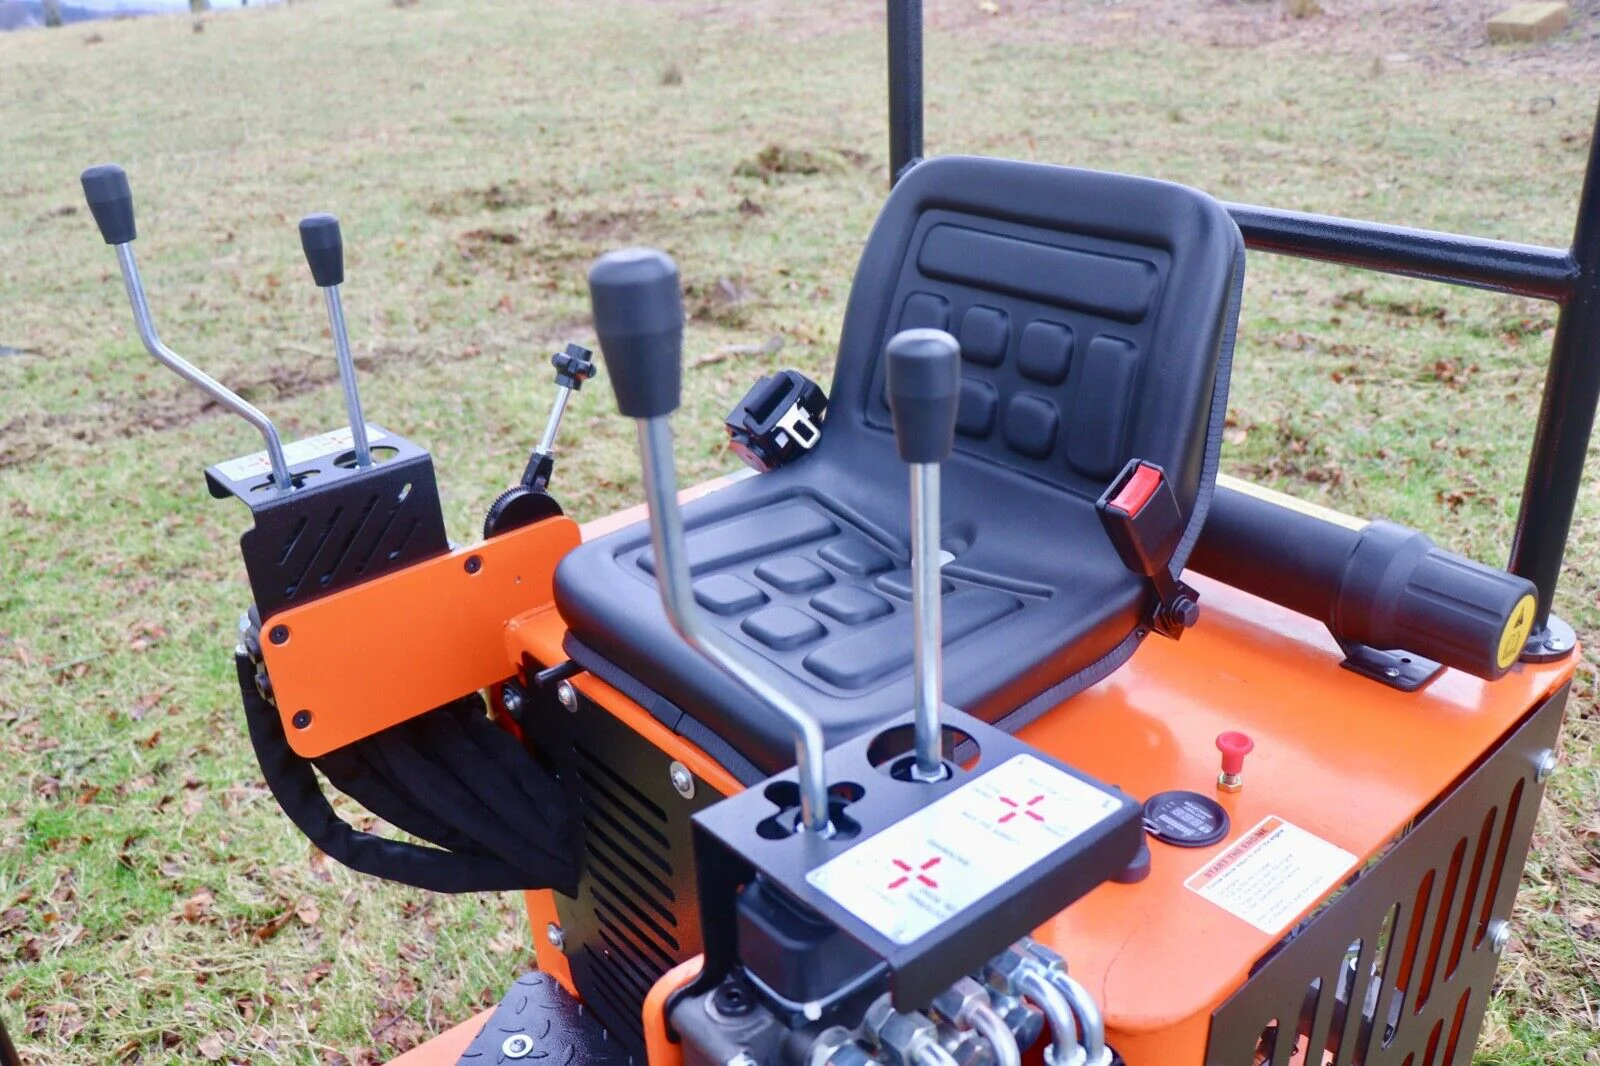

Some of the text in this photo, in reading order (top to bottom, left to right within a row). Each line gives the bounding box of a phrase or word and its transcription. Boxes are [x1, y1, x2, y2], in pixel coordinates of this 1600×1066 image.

[1203, 859, 1229, 878] START
[1226, 848, 1243, 860] THE
[1241, 828, 1270, 848] ENGINE
